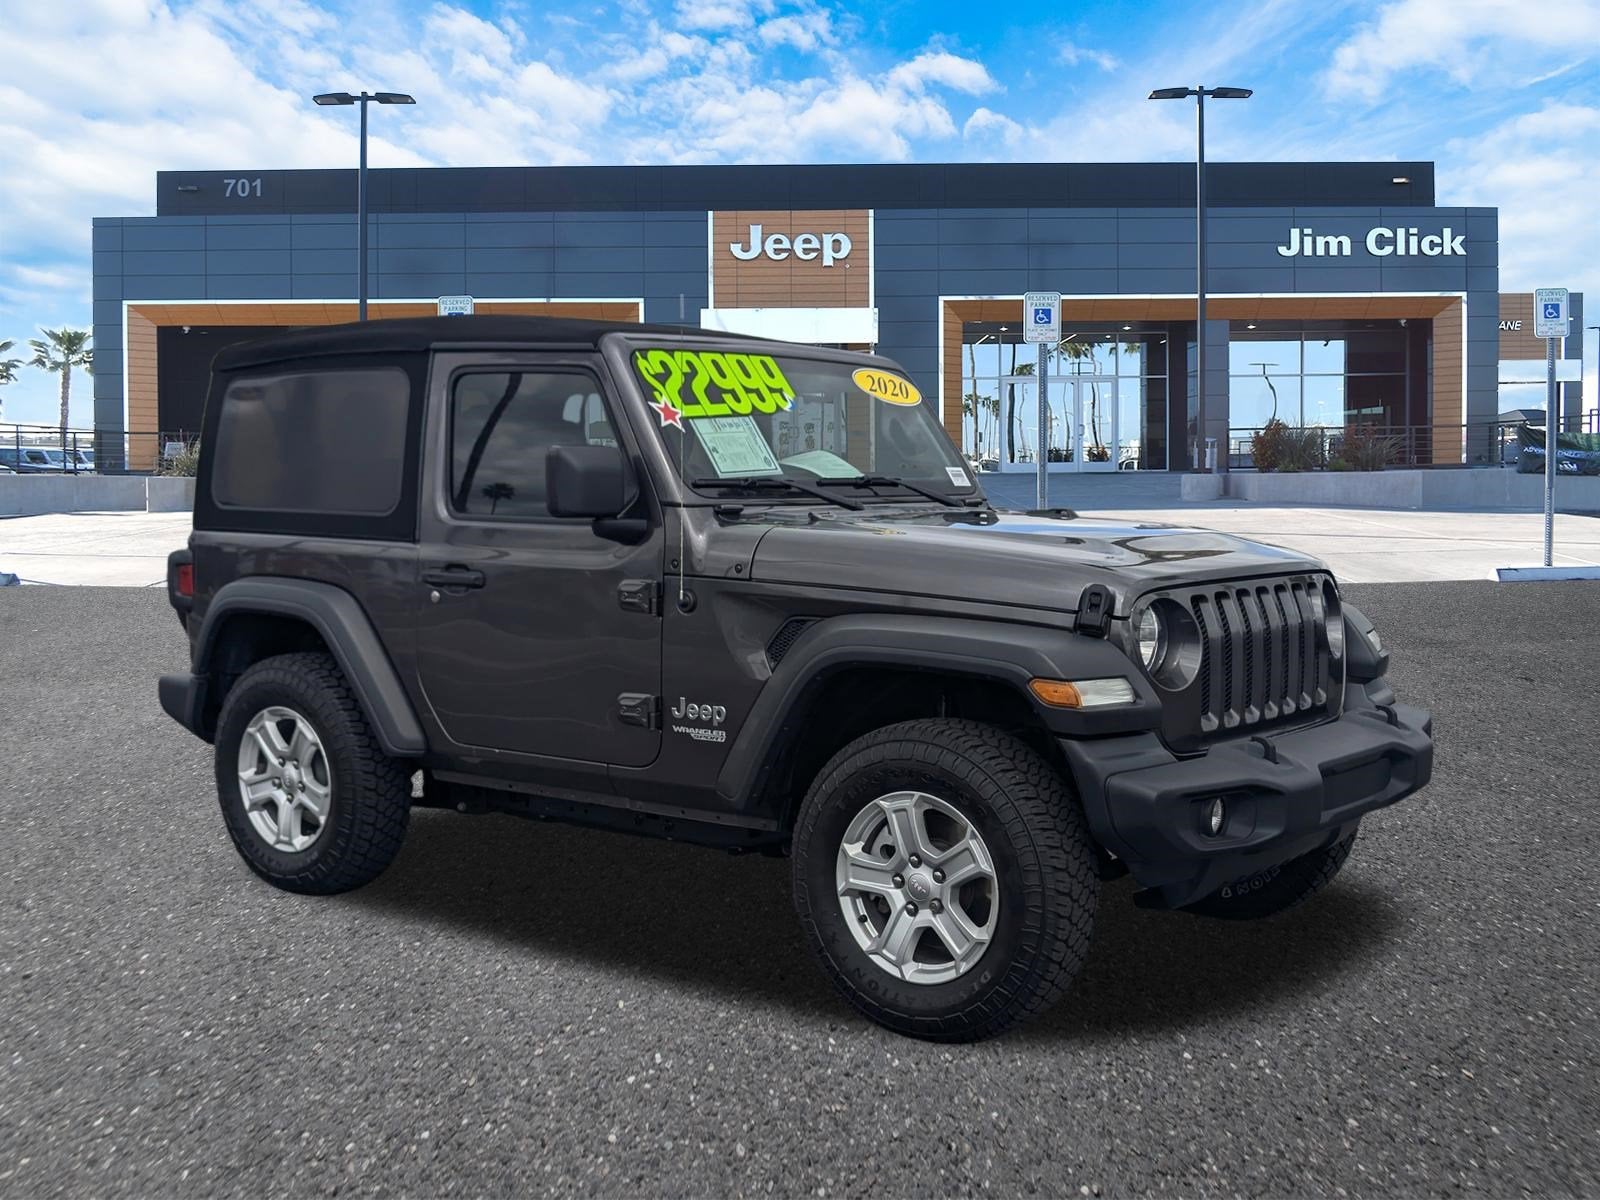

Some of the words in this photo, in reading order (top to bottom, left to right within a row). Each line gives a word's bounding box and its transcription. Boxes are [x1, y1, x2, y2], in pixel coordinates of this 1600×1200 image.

[224, 179, 262, 197] 701
[730, 224, 852, 267] Jeep
[1277, 227, 1352, 257] Jim
[1366, 227, 1467, 257] Click
[1498, 320, 1522, 331] ANE
[635, 350, 796, 417] $22999
[865, 374, 909, 399] 2020
[671, 696, 727, 727] Jeep
[672, 725, 727, 738] WRANGLER
